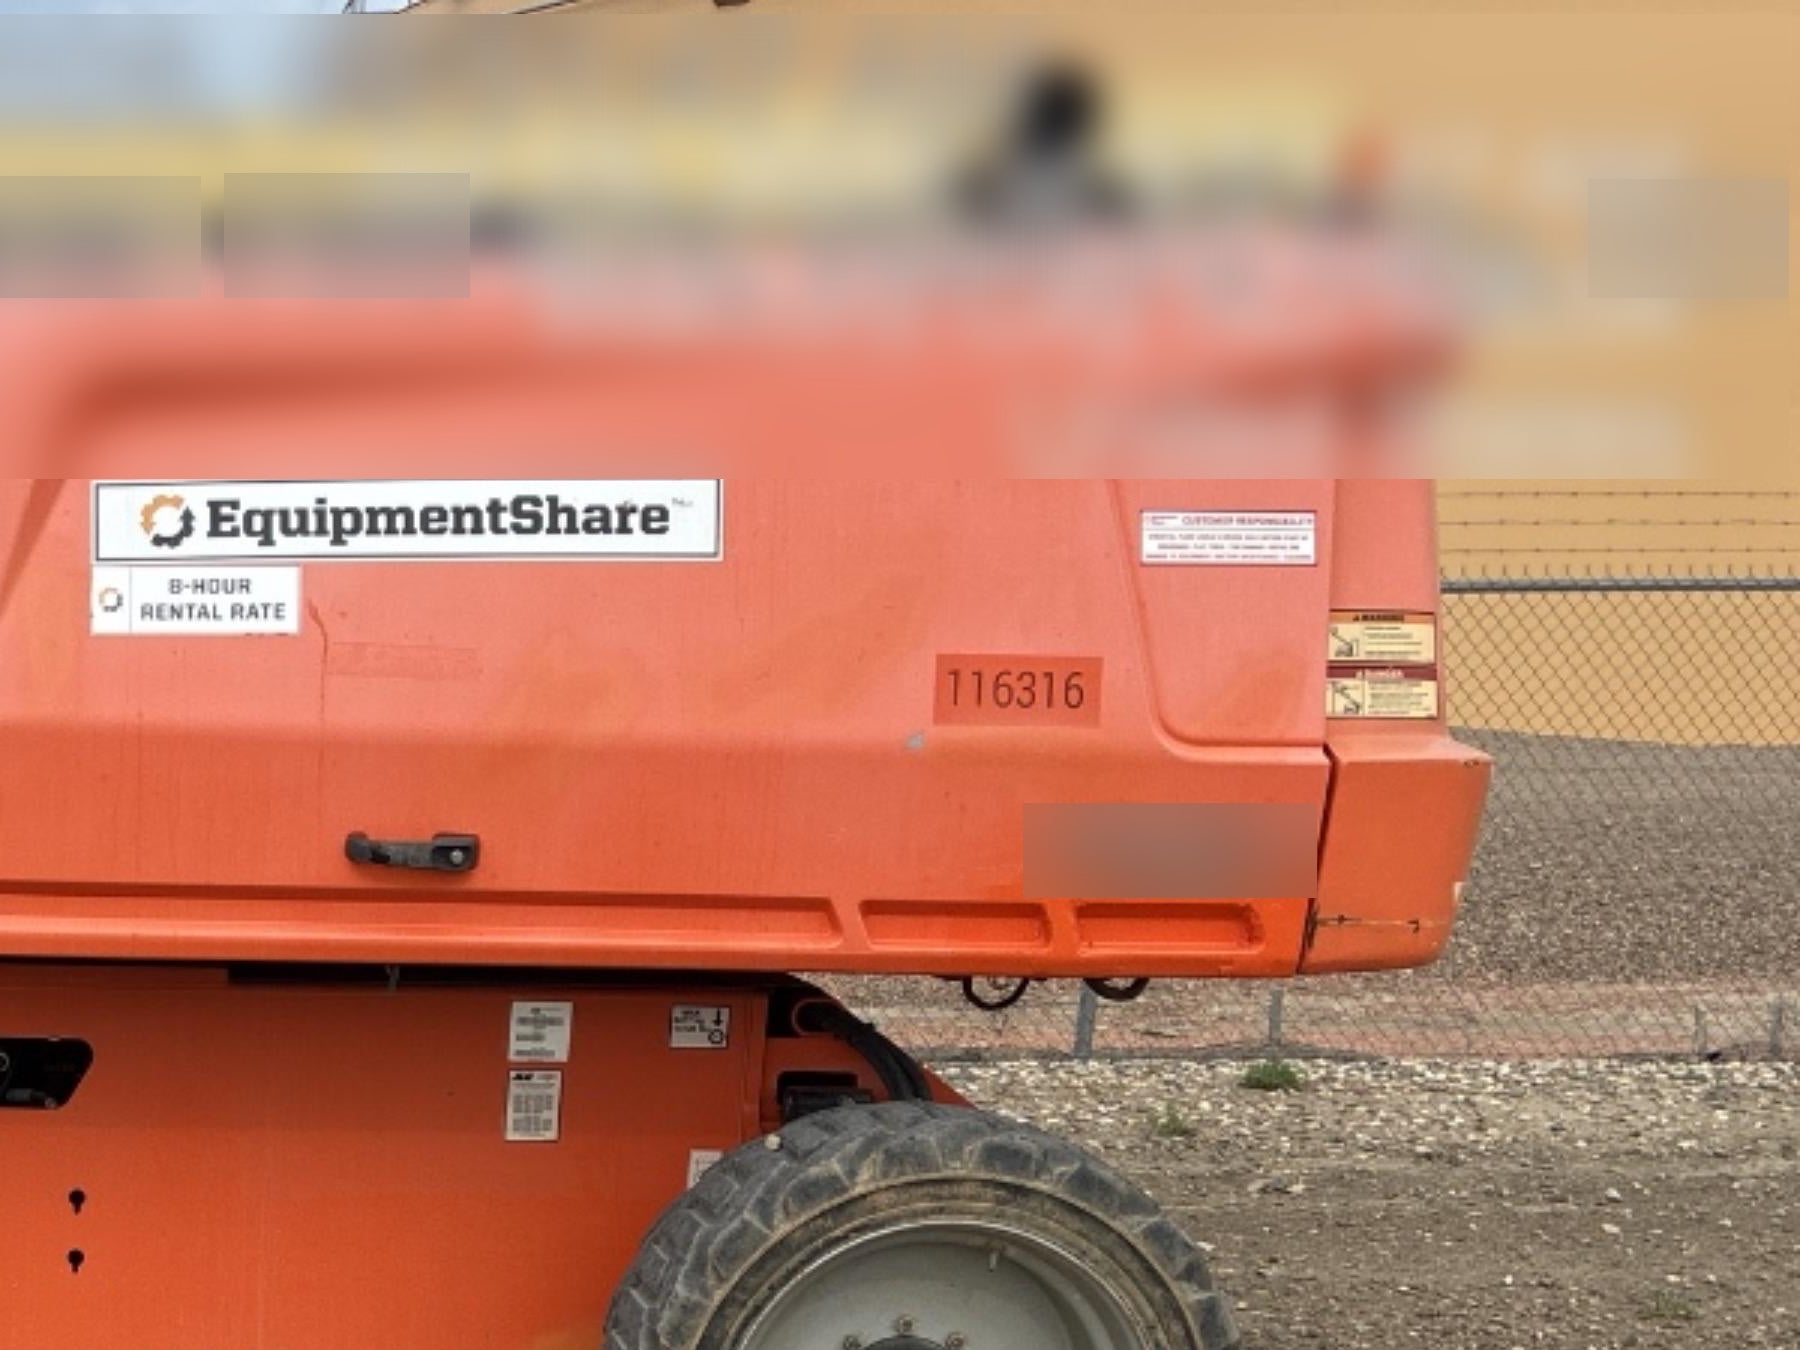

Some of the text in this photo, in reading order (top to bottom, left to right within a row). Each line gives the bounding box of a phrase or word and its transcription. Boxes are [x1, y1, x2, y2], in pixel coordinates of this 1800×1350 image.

[206, 495, 671, 546] EquipmentShare
[168, 578, 251, 594] 8-HOUR
[140, 602, 286, 621] RENTAL RATE
[948, 669, 1084, 709] 116316
